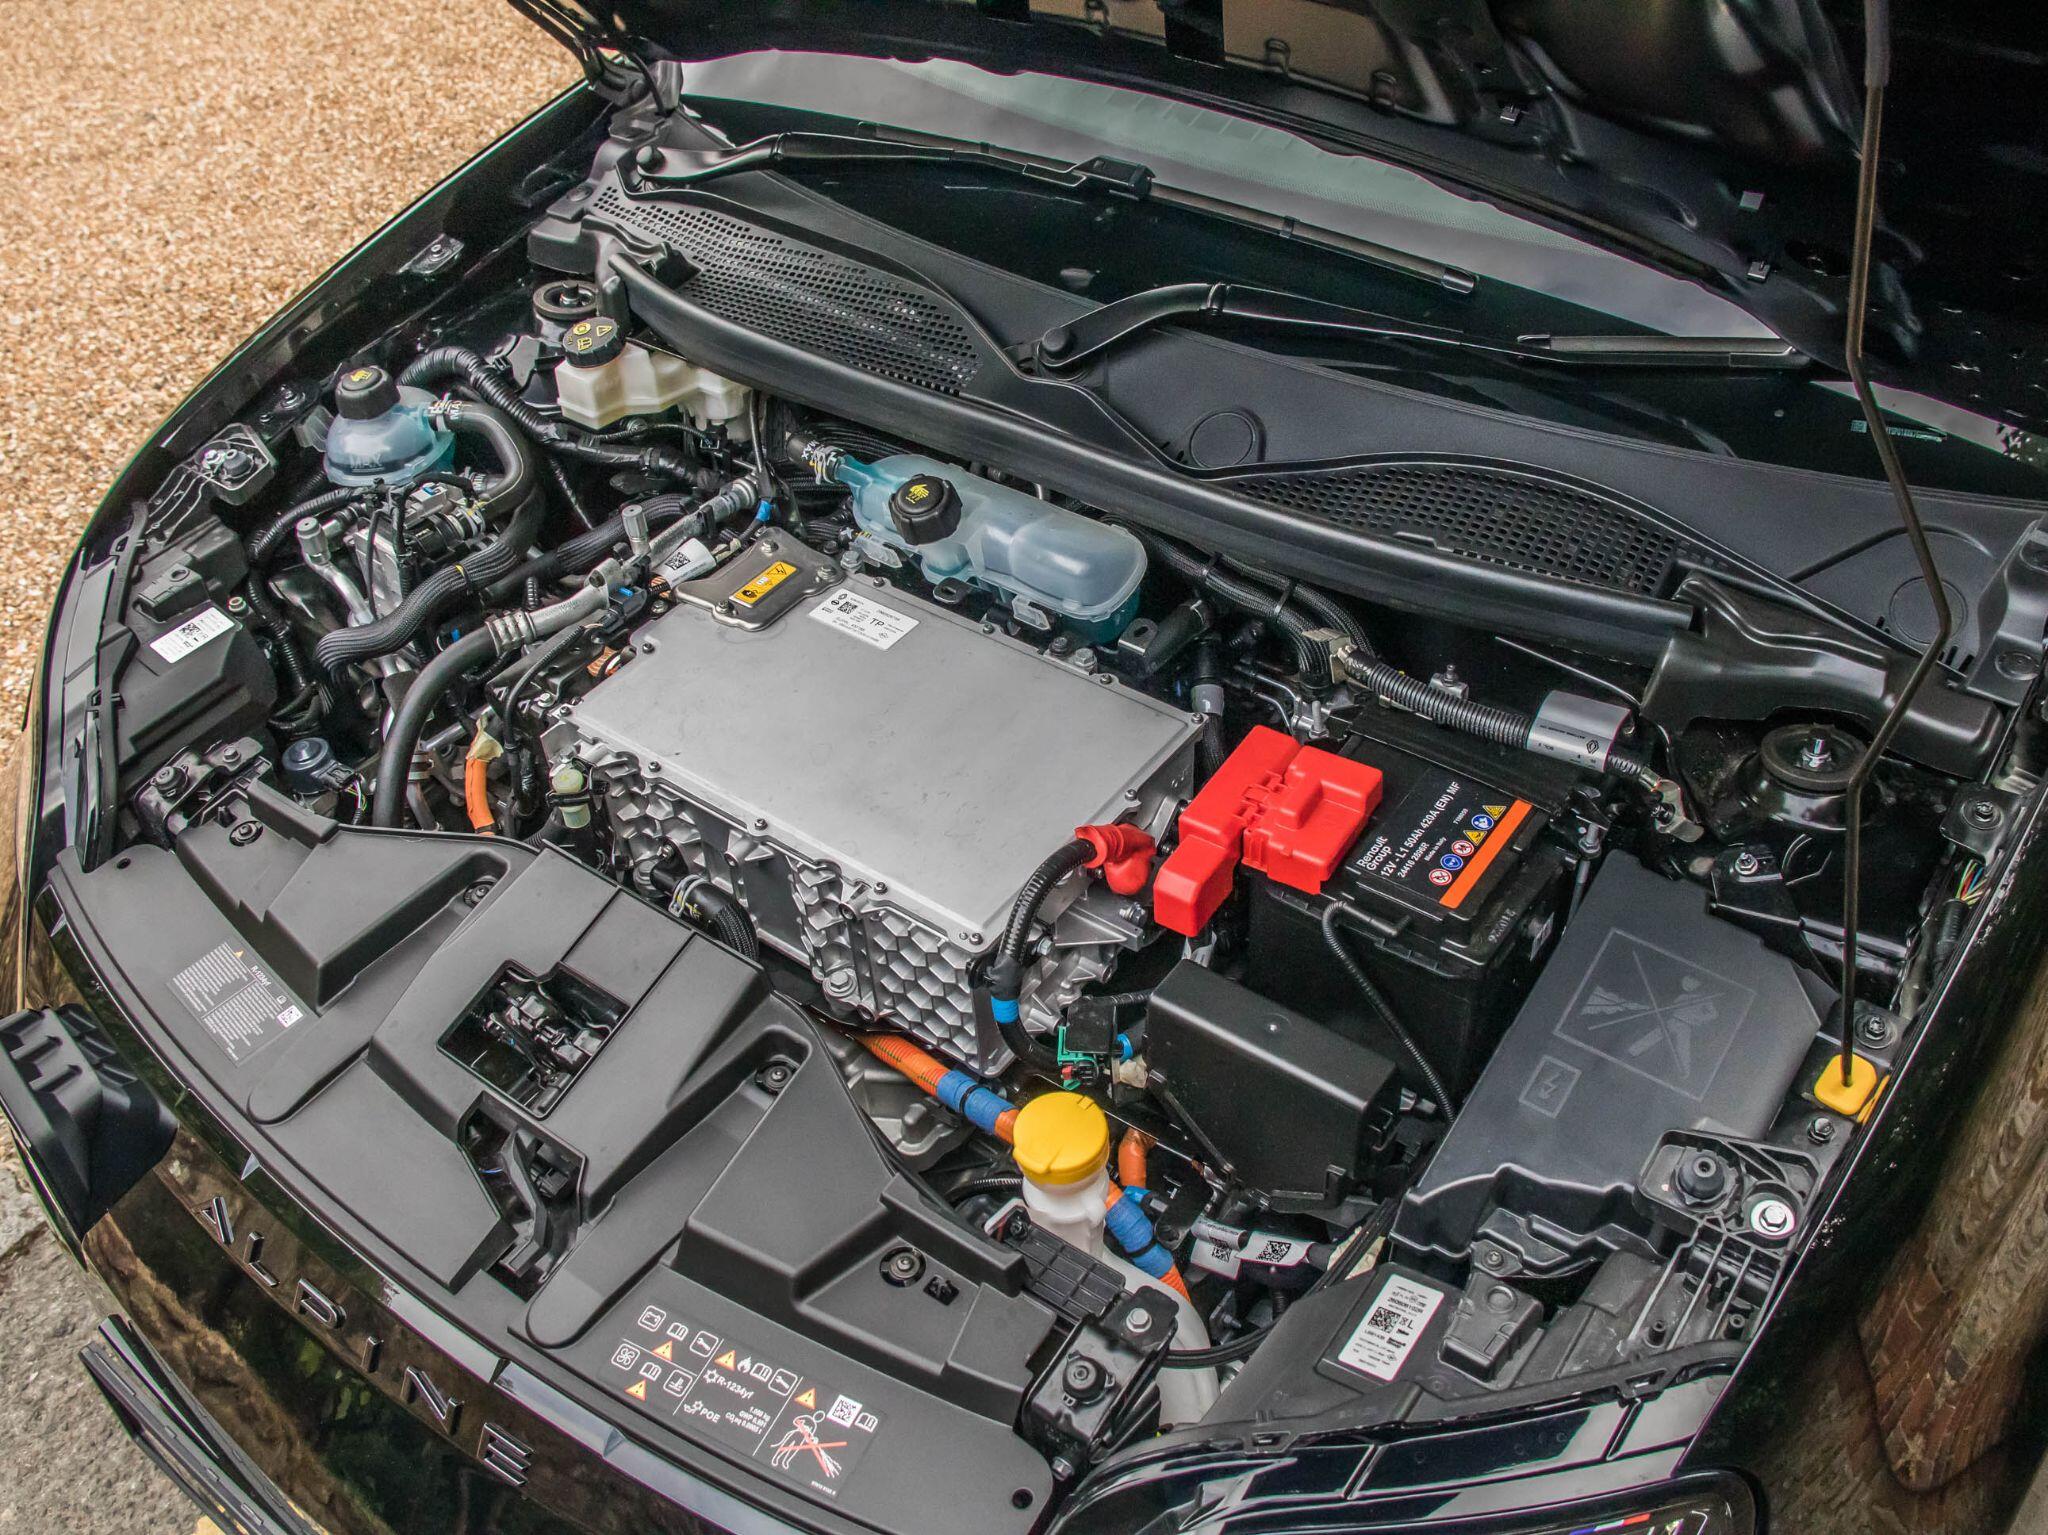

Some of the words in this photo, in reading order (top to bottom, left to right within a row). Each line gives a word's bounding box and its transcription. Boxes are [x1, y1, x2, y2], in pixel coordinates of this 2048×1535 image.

[870, 617, 885, 627] TP
[1380, 861, 1398, 877] 12V
[1395, 846, 1410, 859] L1
[1403, 828, 1425, 848] 50Ah
[1420, 809, 1440, 829] 420A
[1434, 793, 1454, 811] (EN)
[1446, 781, 1460, 795] MF
[1356, 835, 1388, 867] Renault
[1367, 846, 1392, 871] Group
[199, 1196, 536, 1487] ALPINE
[716, 1375, 755, 1399] R-1234yf
[700, 1407, 721, 1423] POE
